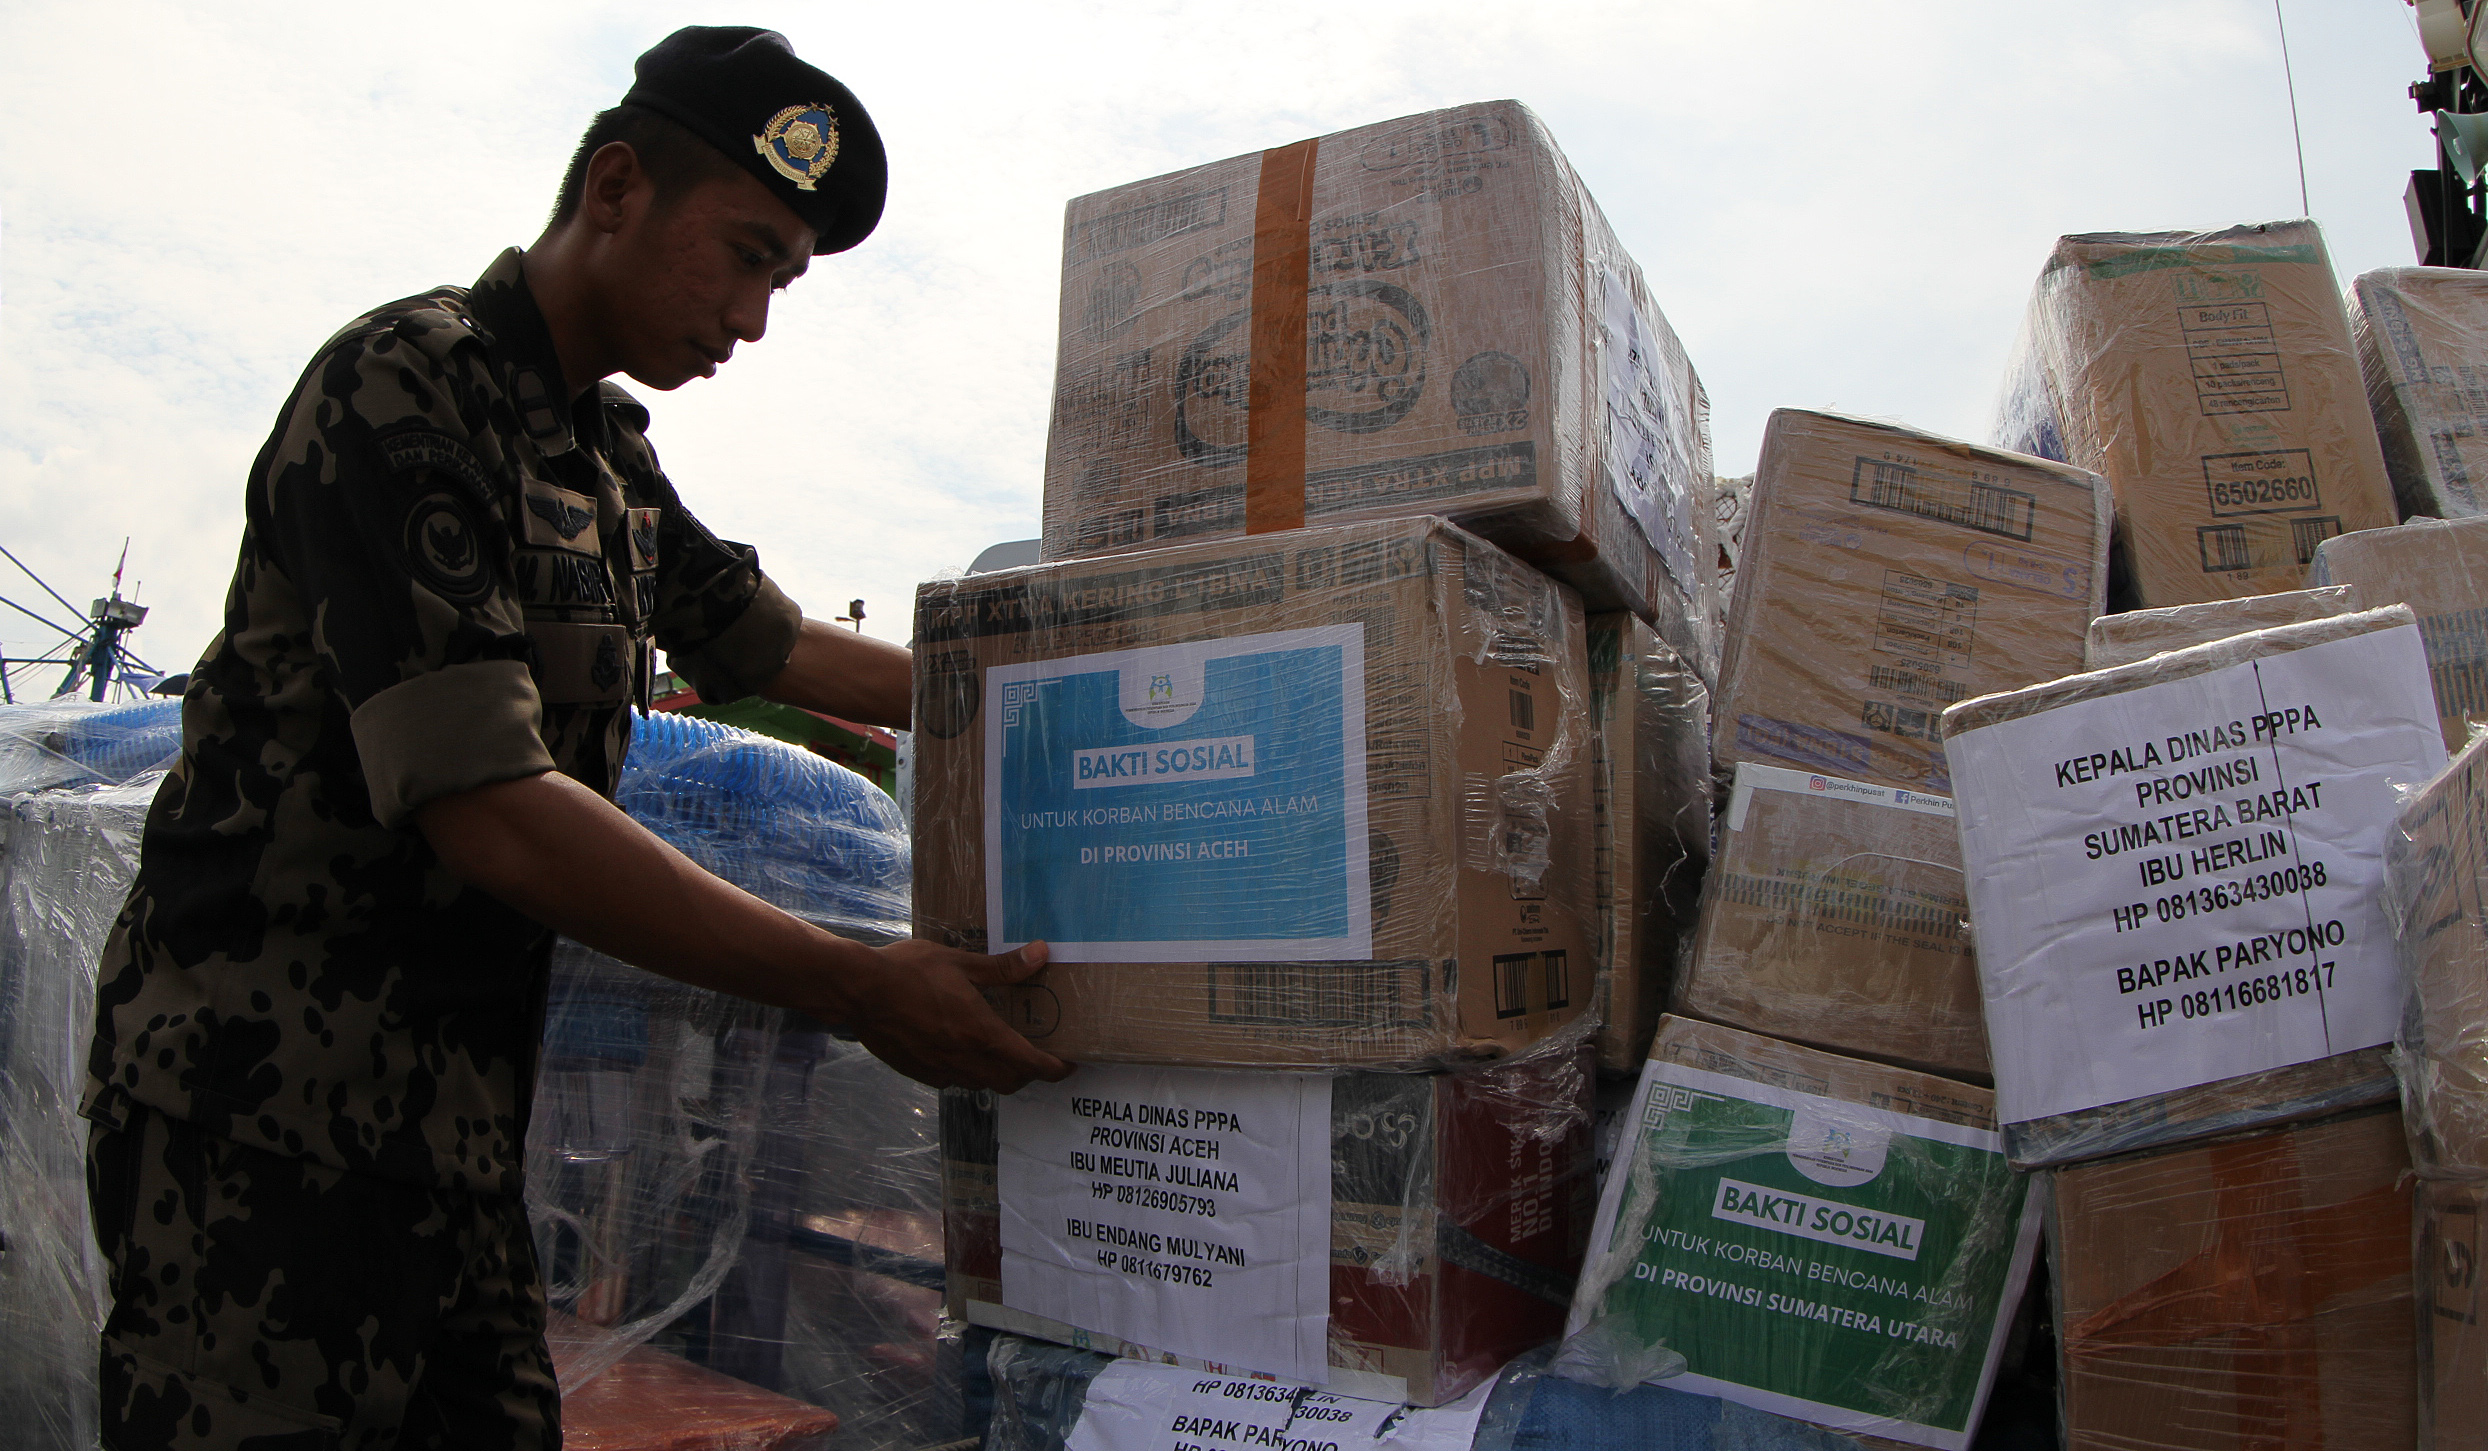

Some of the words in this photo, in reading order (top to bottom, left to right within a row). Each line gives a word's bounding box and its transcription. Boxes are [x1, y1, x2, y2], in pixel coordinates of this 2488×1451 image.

[1373, 465, 1449, 494] XTRA
[1458, 455, 1521, 484] MPP
[2231, 462, 2254, 472] Item
[1306, 476, 1363, 505] KER
[2214, 475, 2313, 506] 6502660
[1063, 580, 1164, 611] KERING
[1079, 751, 1148, 780] BAKTI
[1155, 744, 1249, 774] SOSIAL
[2054, 742, 2163, 788] KEPALA
[2166, 721, 2247, 763] DINAS
[2251, 705, 2322, 742] PPPA
[1826, 781, 1886, 797] @perkhinpusat
[2135, 756, 2260, 808] PROVINSI
[1021, 809, 1078, 829] UNTUK
[1083, 805, 1156, 826] KORBAN
[1164, 798, 1257, 821] BENCANA
[1261, 795, 1319, 816] ALAM
[1910, 795, 1940, 808] Perkhin
[2084, 805, 2232, 860] SUMATERA
[2235, 782, 2322, 825] BARAT
[1081, 848, 1098, 864] DI
[1105, 842, 1191, 862] PROVINSI
[1197, 840, 1249, 857] ACEH
[2139, 853, 2184, 887] IBU
[2190, 829, 2287, 875] HERLIN
[2112, 902, 2149, 933] HP
[2156, 861, 2327, 923] 081363430038
[1816, 922, 1868, 940] ACCEPT
[1886, 934, 1909, 946] THE
[1913, 939, 1945, 954] SEAL
[2116, 949, 2211, 994] BAPAK
[2215, 919, 2345, 972] PARYONO
[2137, 998, 2173, 1029] HP
[2181, 961, 2336, 1020] 08116681817
[1071, 1097, 1133, 1123] KEPALA
[1138, 1104, 1189, 1128] DINAS
[1194, 1110, 1242, 1133] PPPA
[1090, 1126, 1165, 1154] PROVINSI
[1168, 1135, 1220, 1160] ACEH
[1070, 1151, 1095, 1172] IBU
[1100, 1155, 1160, 1182] MEUTIA
[1165, 1165, 1240, 1193] JULIANA
[1091, 1181, 1113, 1200] HP
[1117, 1185, 1216, 1218] 08126905793
[1510, 1174, 1523, 1244] MEREK
[1539, 1207, 1553, 1233] DI
[1721, 1186, 1807, 1227] BAKTI
[1810, 1206, 1914, 1250] SOSIAL
[1067, 1218, 1092, 1240] IBU
[1096, 1223, 1161, 1253] ENDANG
[1167, 1236, 1246, 1267] MULYANI
[1097, 1249, 1118, 1269] HP
[1121, 1254, 1213, 1288] 0811679762
[1641, 1224, 1710, 1255] UNTUK
[1714, 1240, 1801, 1276] KORBAN
[1807, 1263, 1908, 1299] BENCANA
[1913, 1285, 1974, 1312] ALAM
[1634, 1262, 1657, 1281] DI
[1661, 1268, 1763, 1306] PROVINSI
[1766, 1293, 1882, 1334] SUMATERA
[1888, 1319, 1958, 1349] UTARA
[1192, 1380, 1221, 1394] HP
[1171, 1415, 1241, 1441] BAPAK
